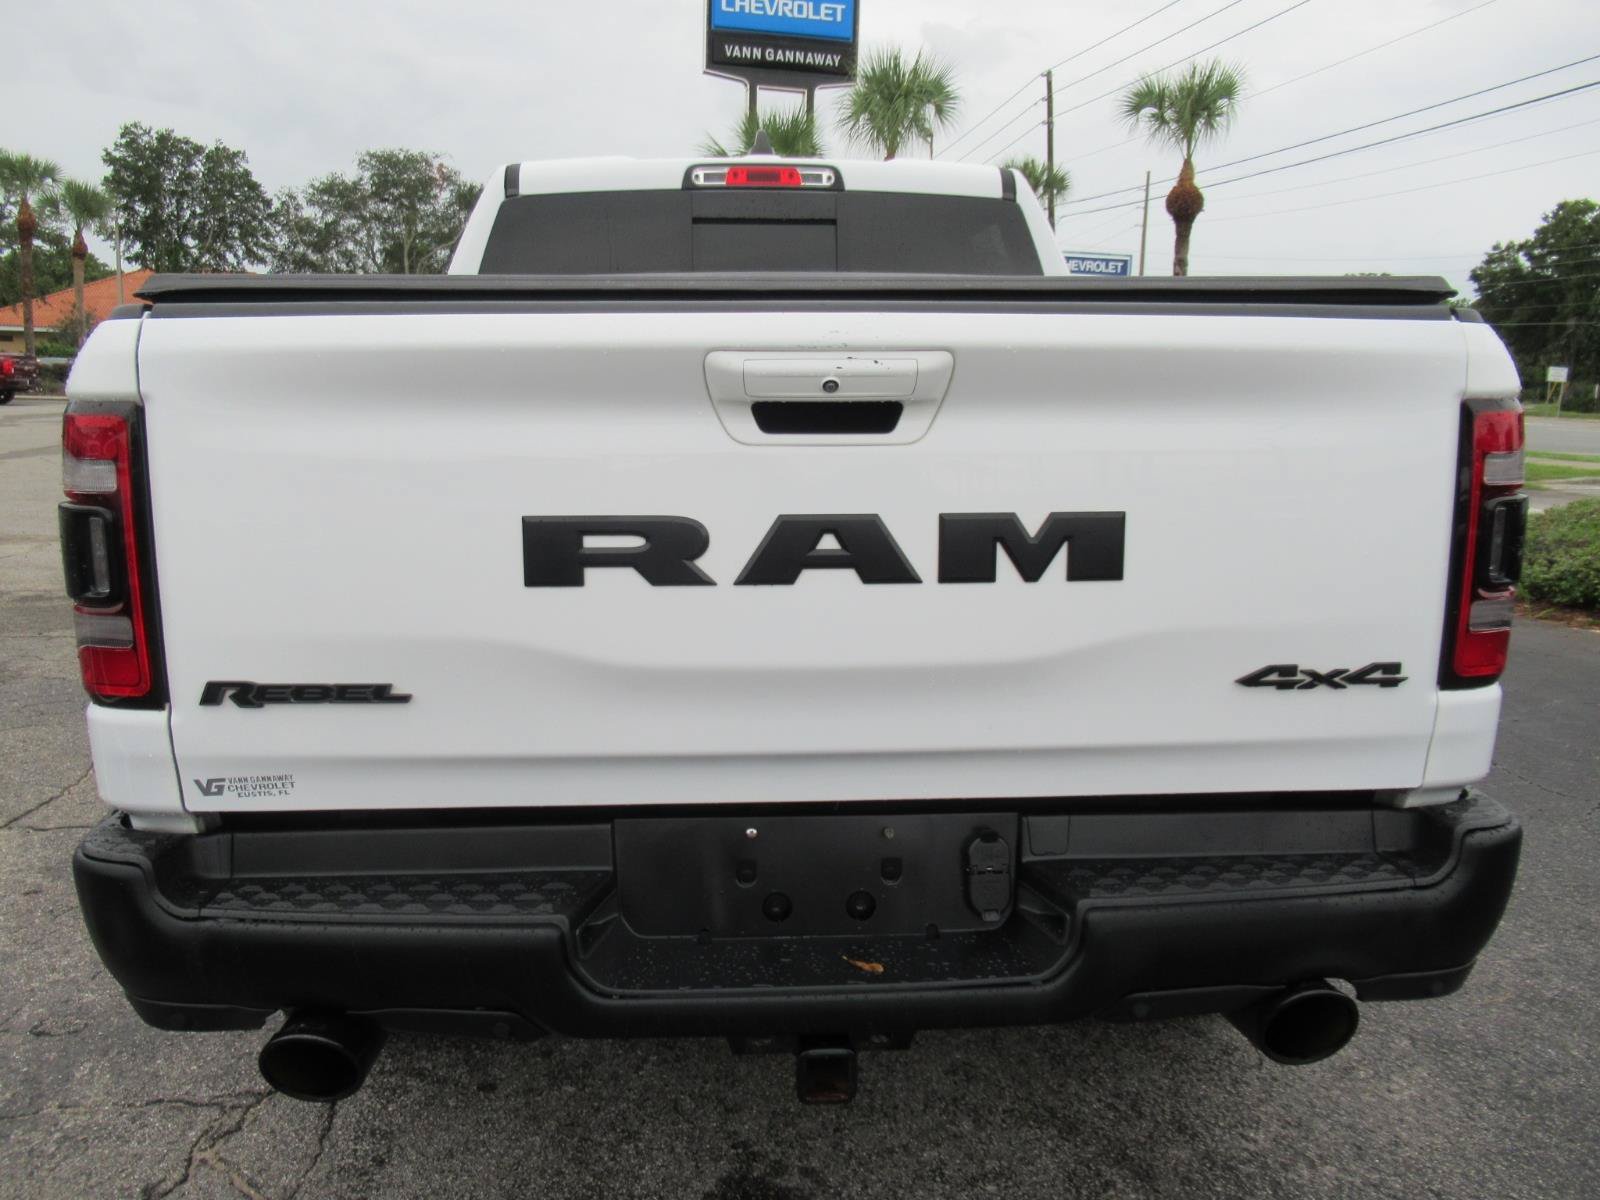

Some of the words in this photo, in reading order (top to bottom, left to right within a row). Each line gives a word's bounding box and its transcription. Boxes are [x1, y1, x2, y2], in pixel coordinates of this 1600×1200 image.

[725, 45, 762, 60] VANN
[765, 49, 842, 67] GANNAWAY
[522, 511, 1126, 586] RAM
[228, 776, 247, 784] VANN
[250, 774, 293, 783] GANNAWAY
[228, 782, 296, 792] CHEVROLET
